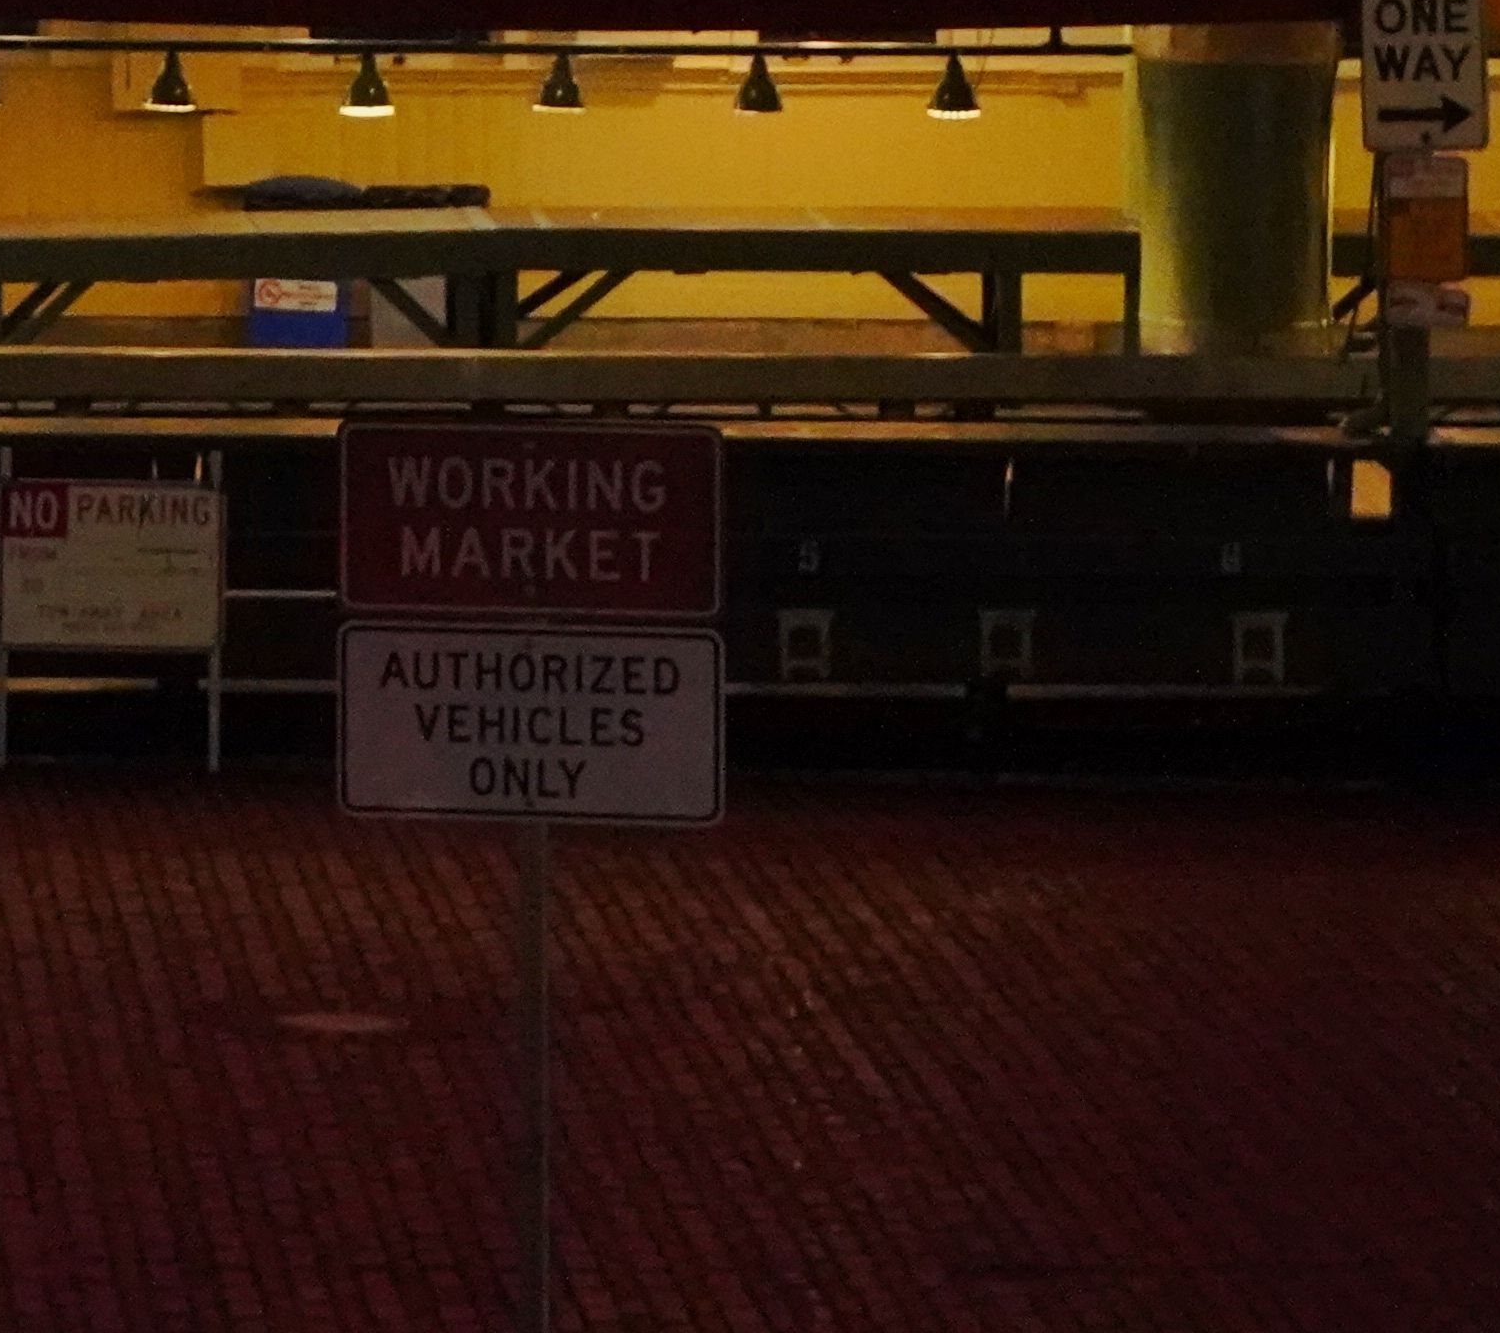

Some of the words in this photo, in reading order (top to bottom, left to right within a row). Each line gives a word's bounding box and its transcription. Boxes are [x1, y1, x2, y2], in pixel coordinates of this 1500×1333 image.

[1374, 45, 1470, 82] WAY
[387, 453, 667, 513] WORKING
[7, 487, 60, 531] NO
[76, 493, 211, 527] PARKING
[399, 525, 662, 582] MARKET
[379, 651, 681, 696] AUTHORIZED
[413, 703, 645, 748] VEHICLES
[469, 755, 588, 800] ONLY
